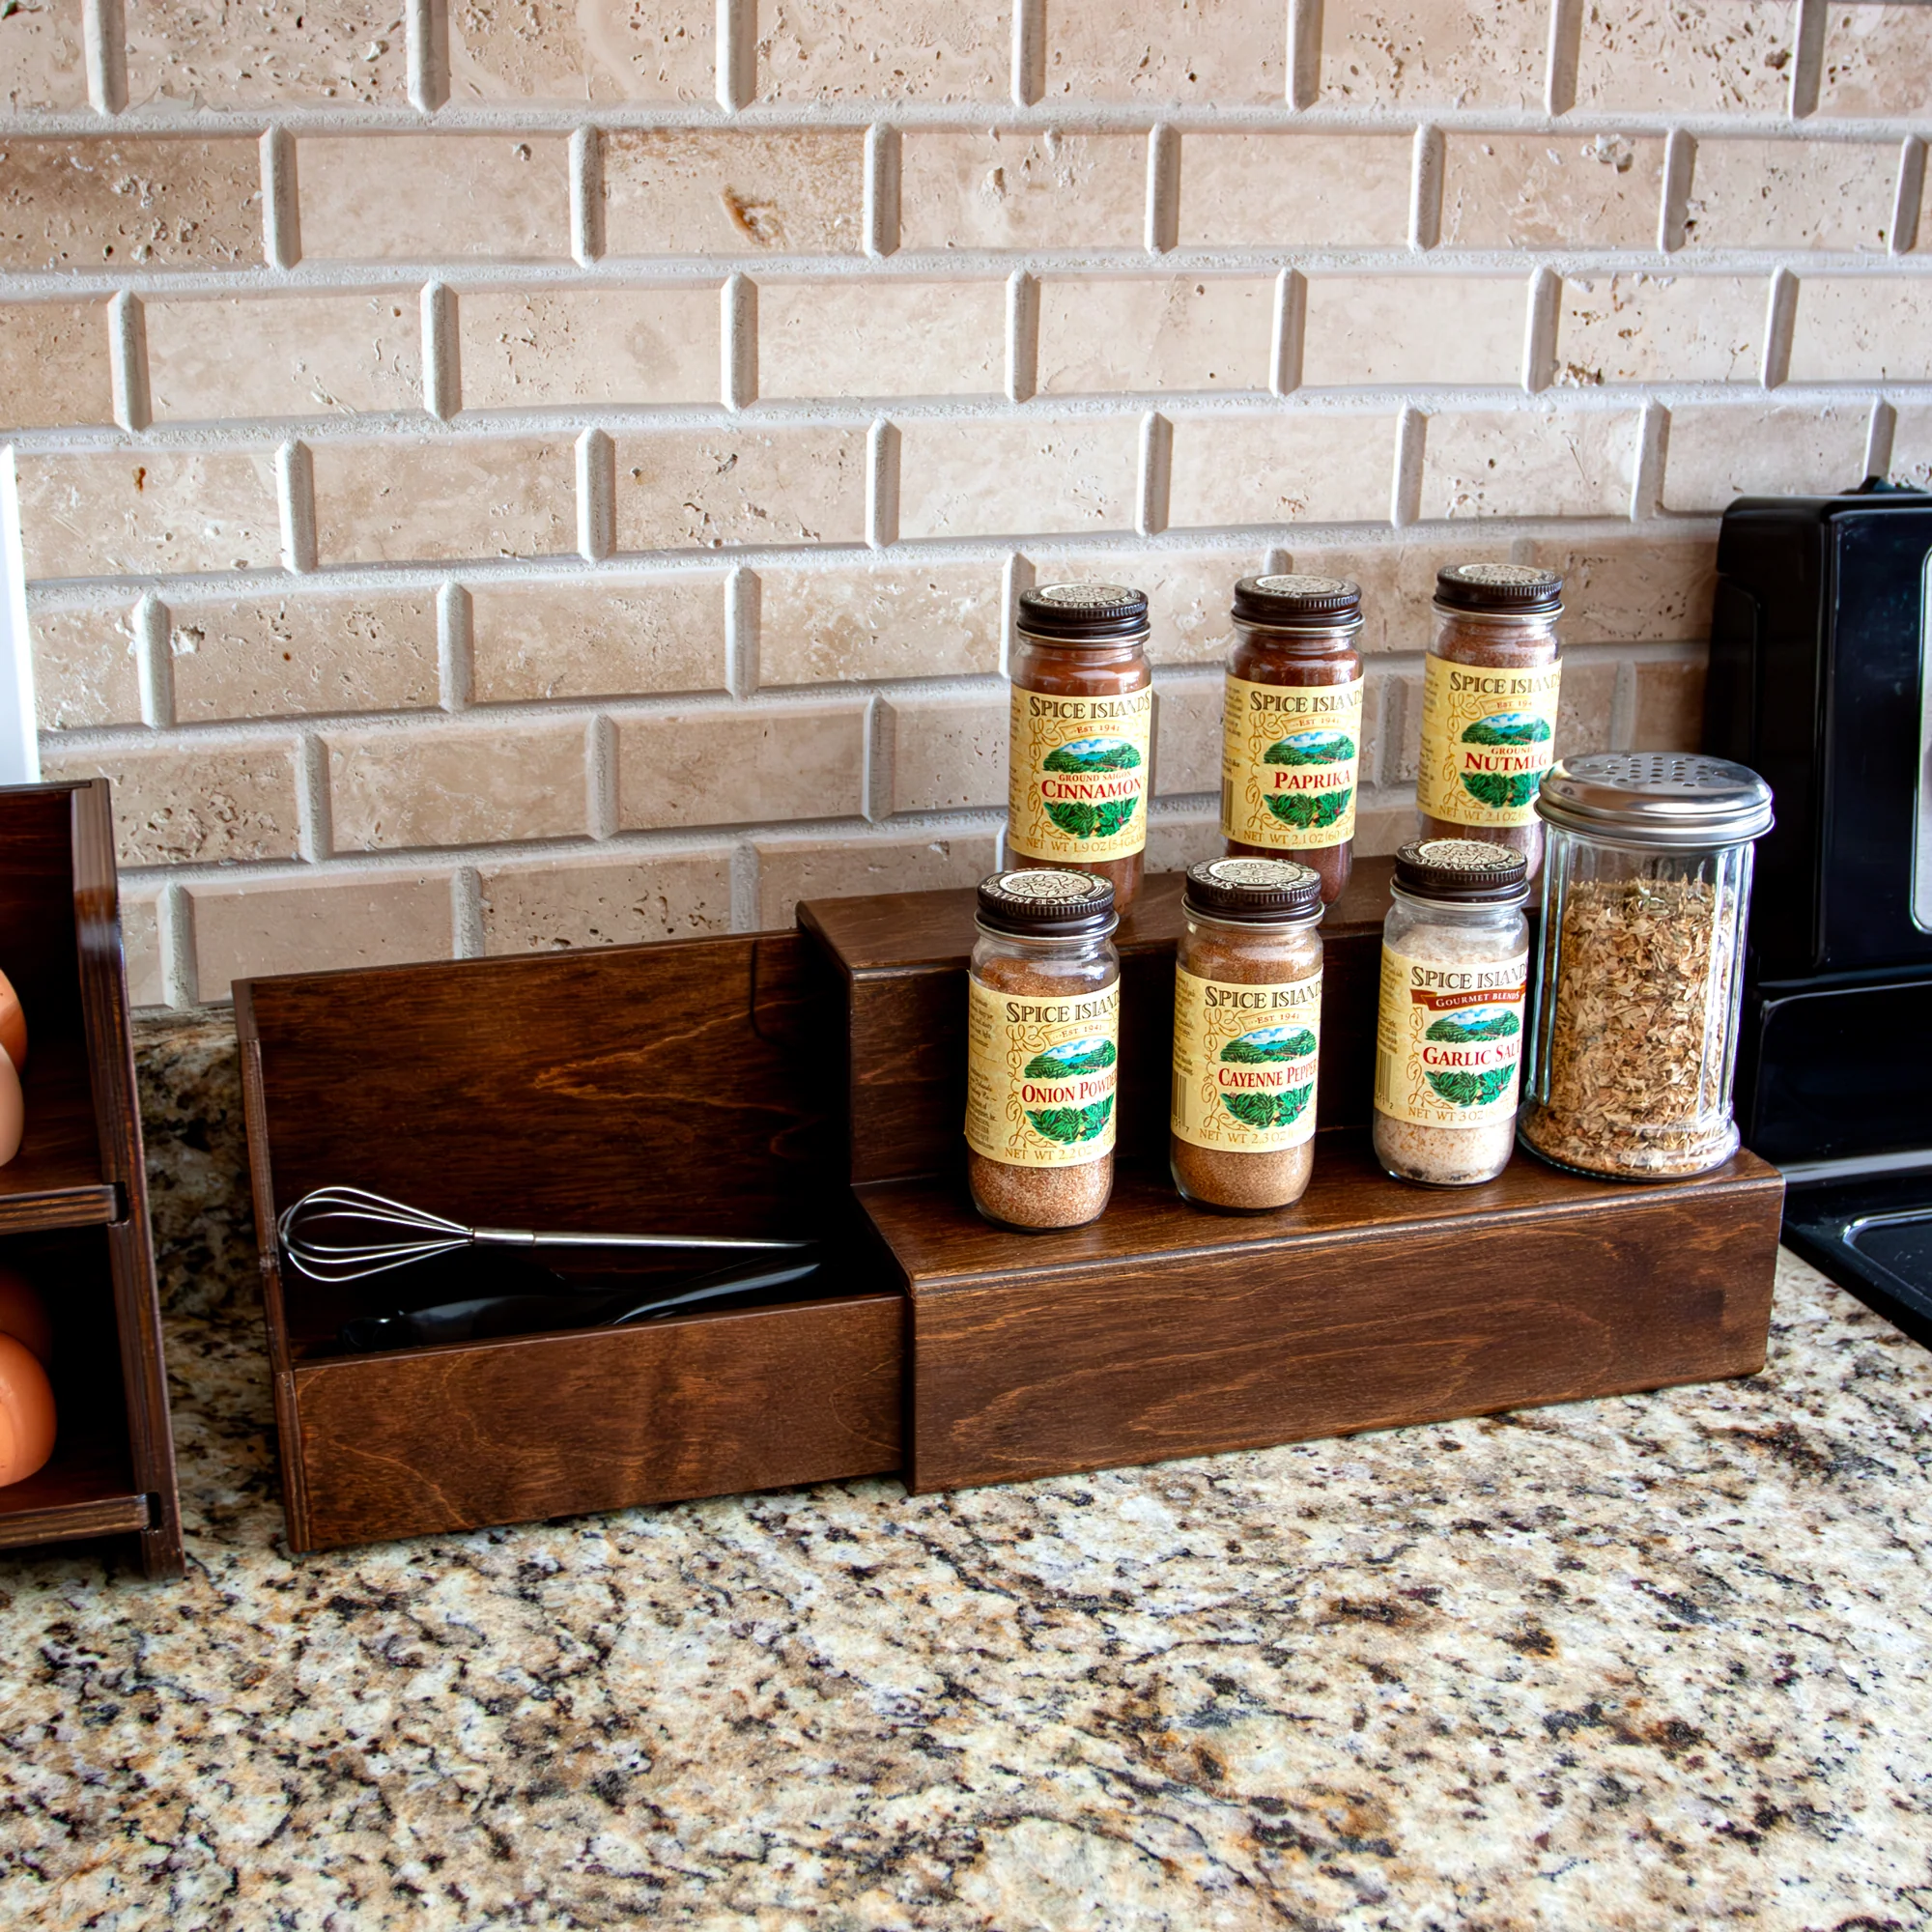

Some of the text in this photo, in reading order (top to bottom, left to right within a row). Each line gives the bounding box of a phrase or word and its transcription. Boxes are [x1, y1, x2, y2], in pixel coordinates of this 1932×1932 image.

[1450, 671, 1506, 695] SPICE
[1029, 696, 1086, 719] SPICE
[1090, 691, 1151, 719] ISLANDS
[1250, 691, 1308, 713] SPICE
[1464, 752, 1548, 772] NUTMEG
[1059, 770, 1131, 782] GROUND SAIGON
[1274, 770, 1351, 789] PAPRIKA
[1041, 776, 1142, 800] CINNAMON
[1438, 805, 1459, 817] NET
[1463, 810, 1483, 821] WT
[1026, 838, 1045, 849] NET
[1051, 840, 1069, 852] WT
[1092, 841, 1107, 852] OZ
[1243, 830, 1264, 843] NET
[1269, 834, 1289, 845] WT
[1309, 833, 1323, 843] OZ
[1411, 966, 1472, 989] SPICE
[1205, 985, 1266, 1009] SPICE
[1435, 991, 1520, 1008] GOURMET BLENDS
[1007, 1002, 1069, 1023] SPICE
[1423, 1038, 1520, 1066] GARLIC SALT
[1218, 1067, 1283, 1088] CAYENNE
[1021, 1084, 1075, 1103] ONION
[1408, 1106, 1484, 1122] NET WT 3 OZ
[1199, 1127, 1221, 1142] NET
[1228, 1132, 1247, 1144] WT
[1271, 1131, 1287, 1143] OZ
[1005, 1147, 1027, 1160] NET
[1034, 1151, 1054, 1161] WT
